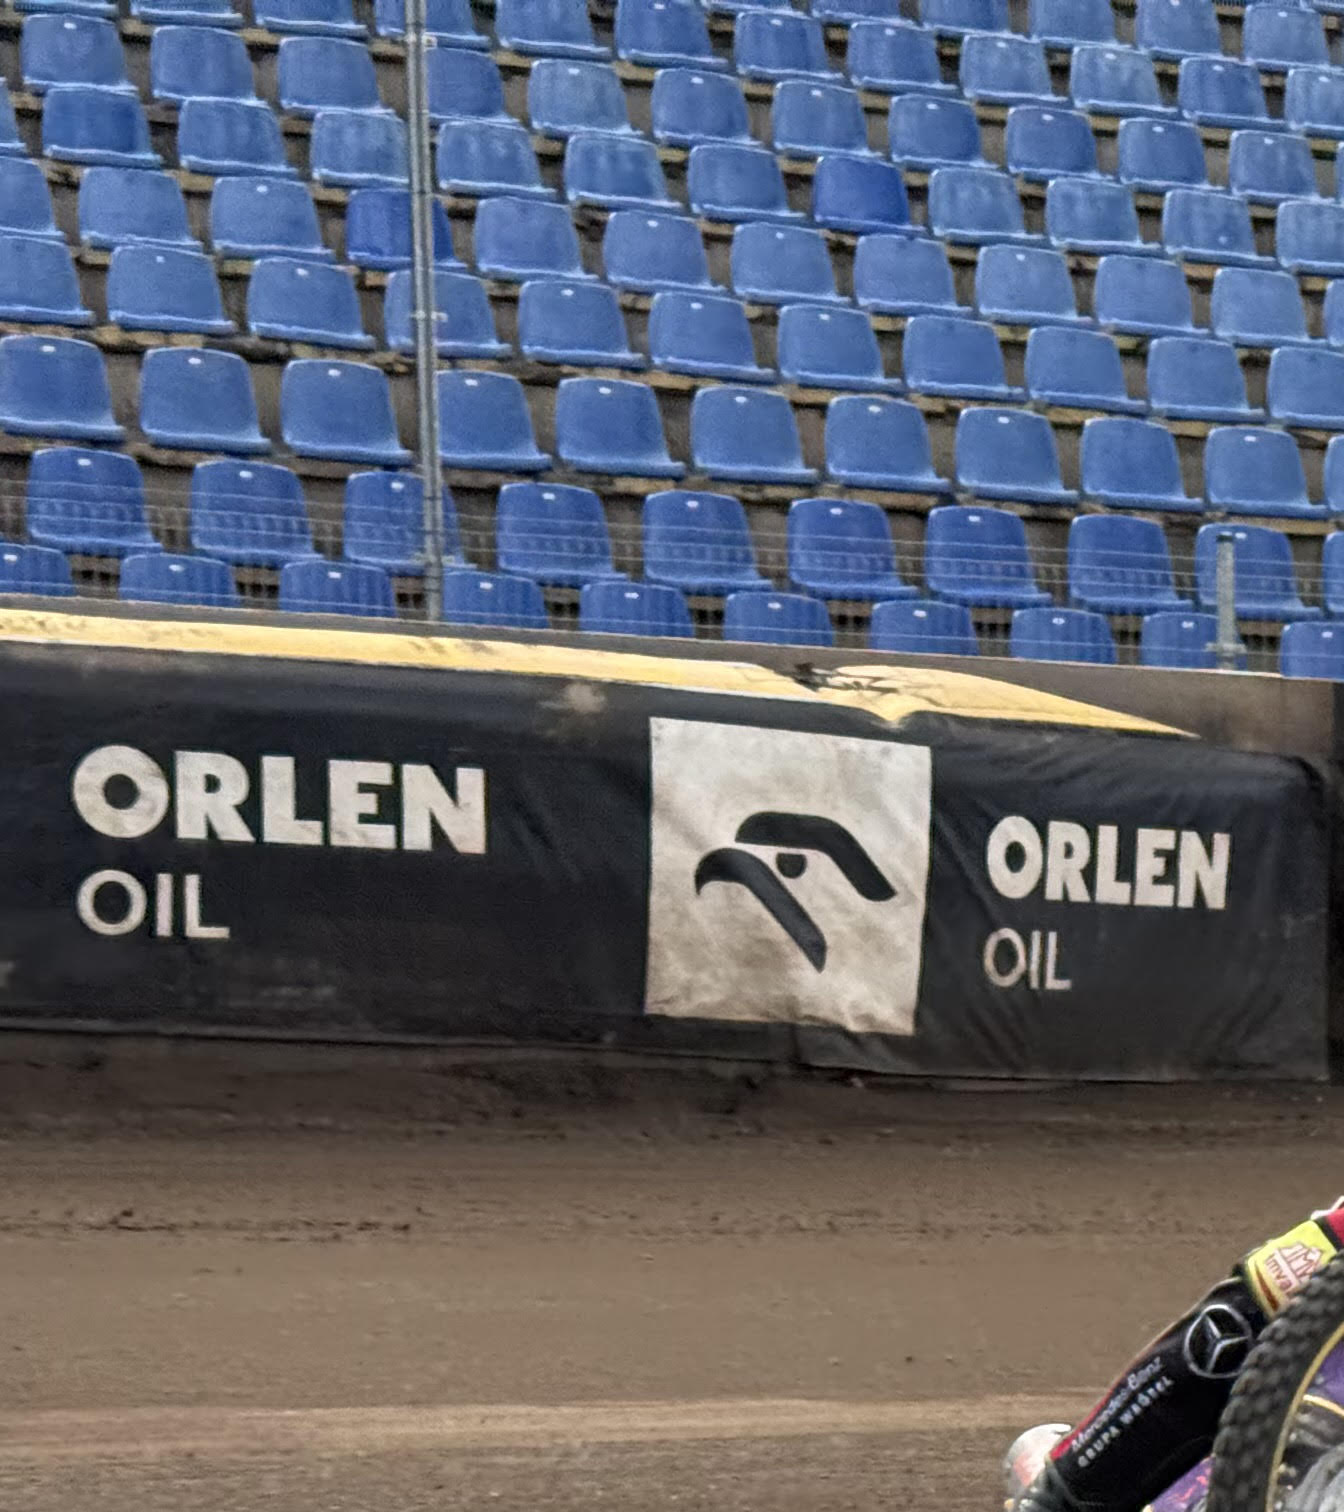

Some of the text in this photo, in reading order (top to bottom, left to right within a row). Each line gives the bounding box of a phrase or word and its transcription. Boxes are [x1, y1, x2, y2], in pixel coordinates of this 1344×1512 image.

[73, 744, 486, 855] ORLEN
[986, 815, 1231, 910] ORLEN
[77, 869, 230, 940] OIL
[983, 927, 1072, 991] OIL
